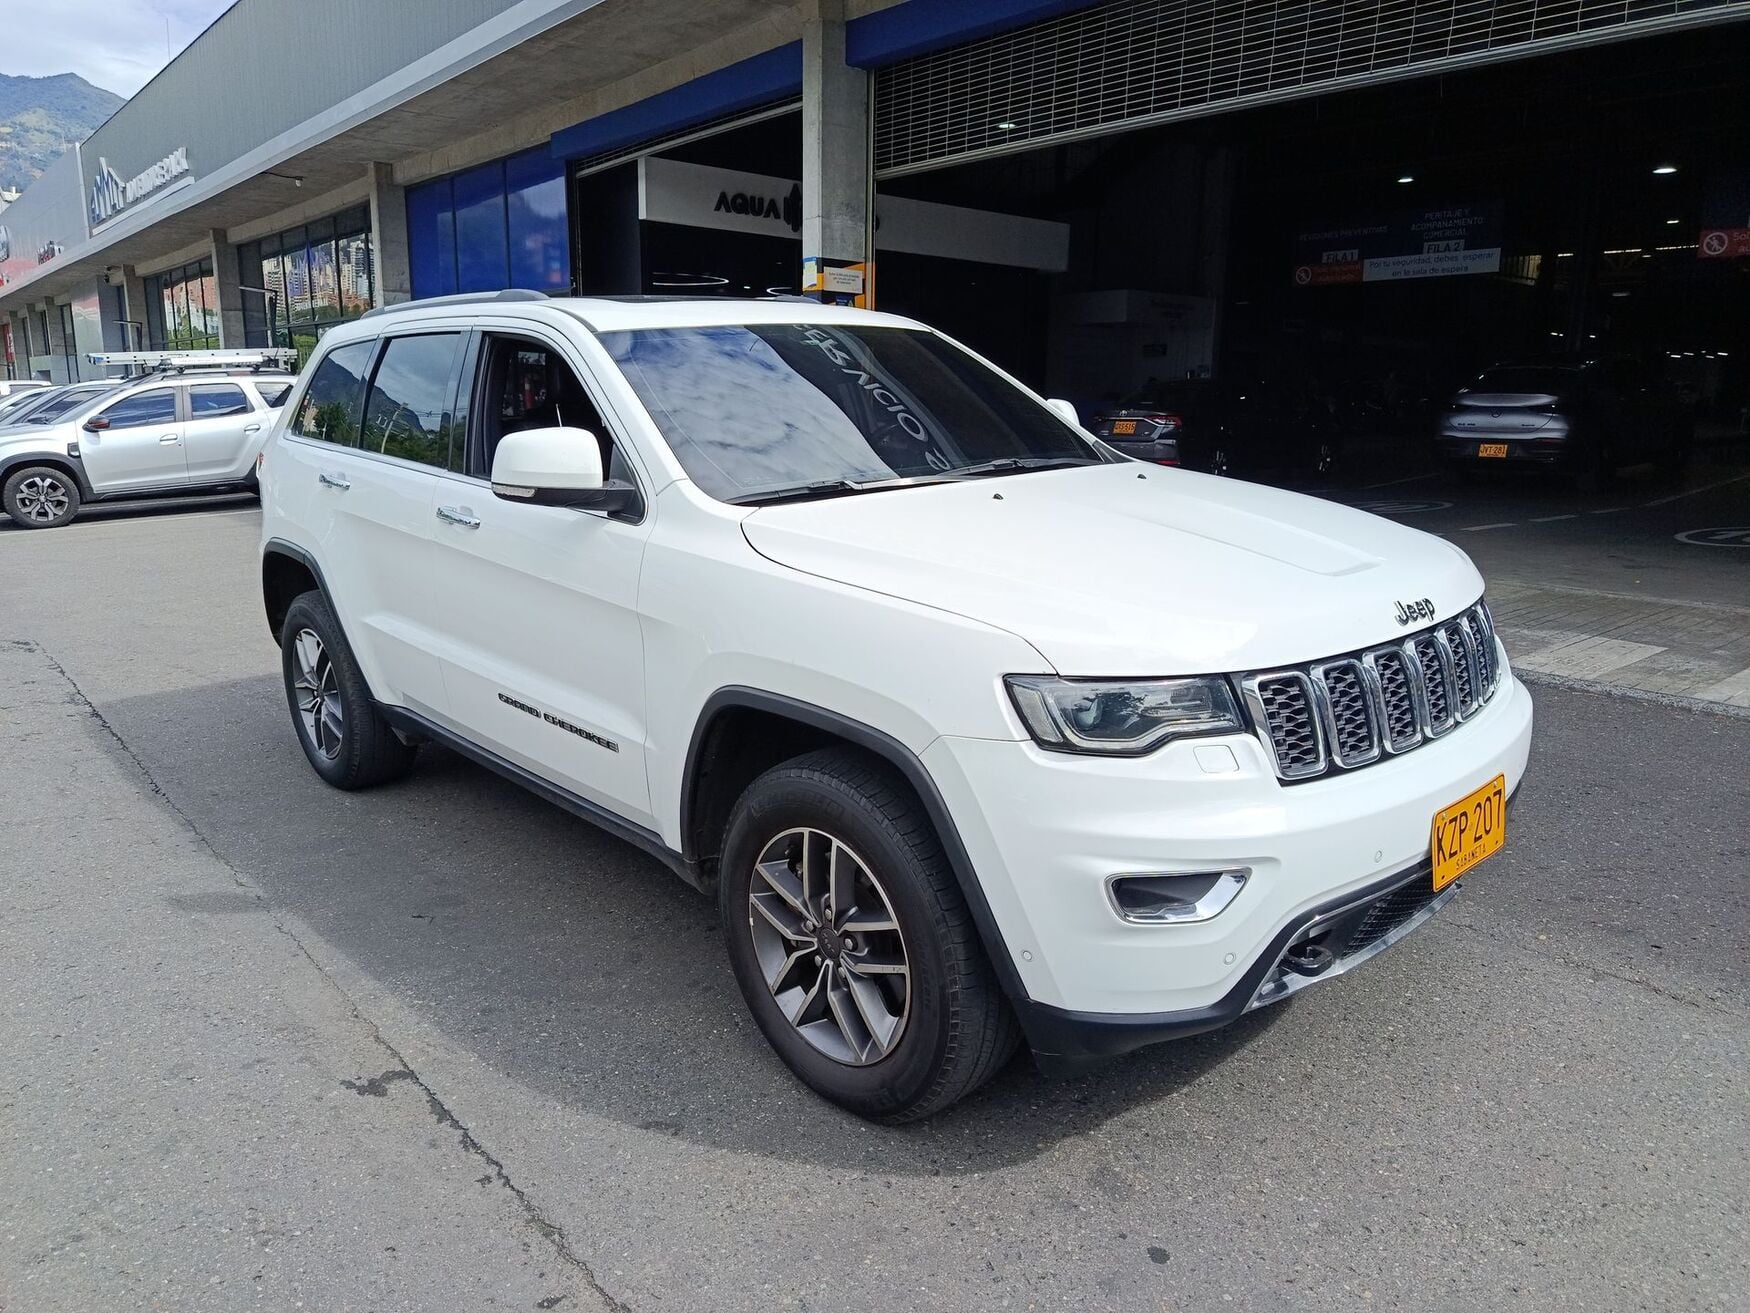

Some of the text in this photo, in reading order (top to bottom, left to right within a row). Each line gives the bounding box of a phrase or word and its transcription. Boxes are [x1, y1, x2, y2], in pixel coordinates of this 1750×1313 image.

[714, 191, 781, 219] AQUA
[1326, 252, 1349, 262] FILA
[1428, 243, 1451, 254] FILA
[1434, 254, 1459, 263] debes
[1463, 251, 1494, 263] esperar
[1392, 264, 1469, 277] en la sala de espera
[1394, 598, 1435, 626] Jeep
[498, 692, 619, 753] GRAND CHEROKEE
[1436, 788, 1502, 867] KZP 207
